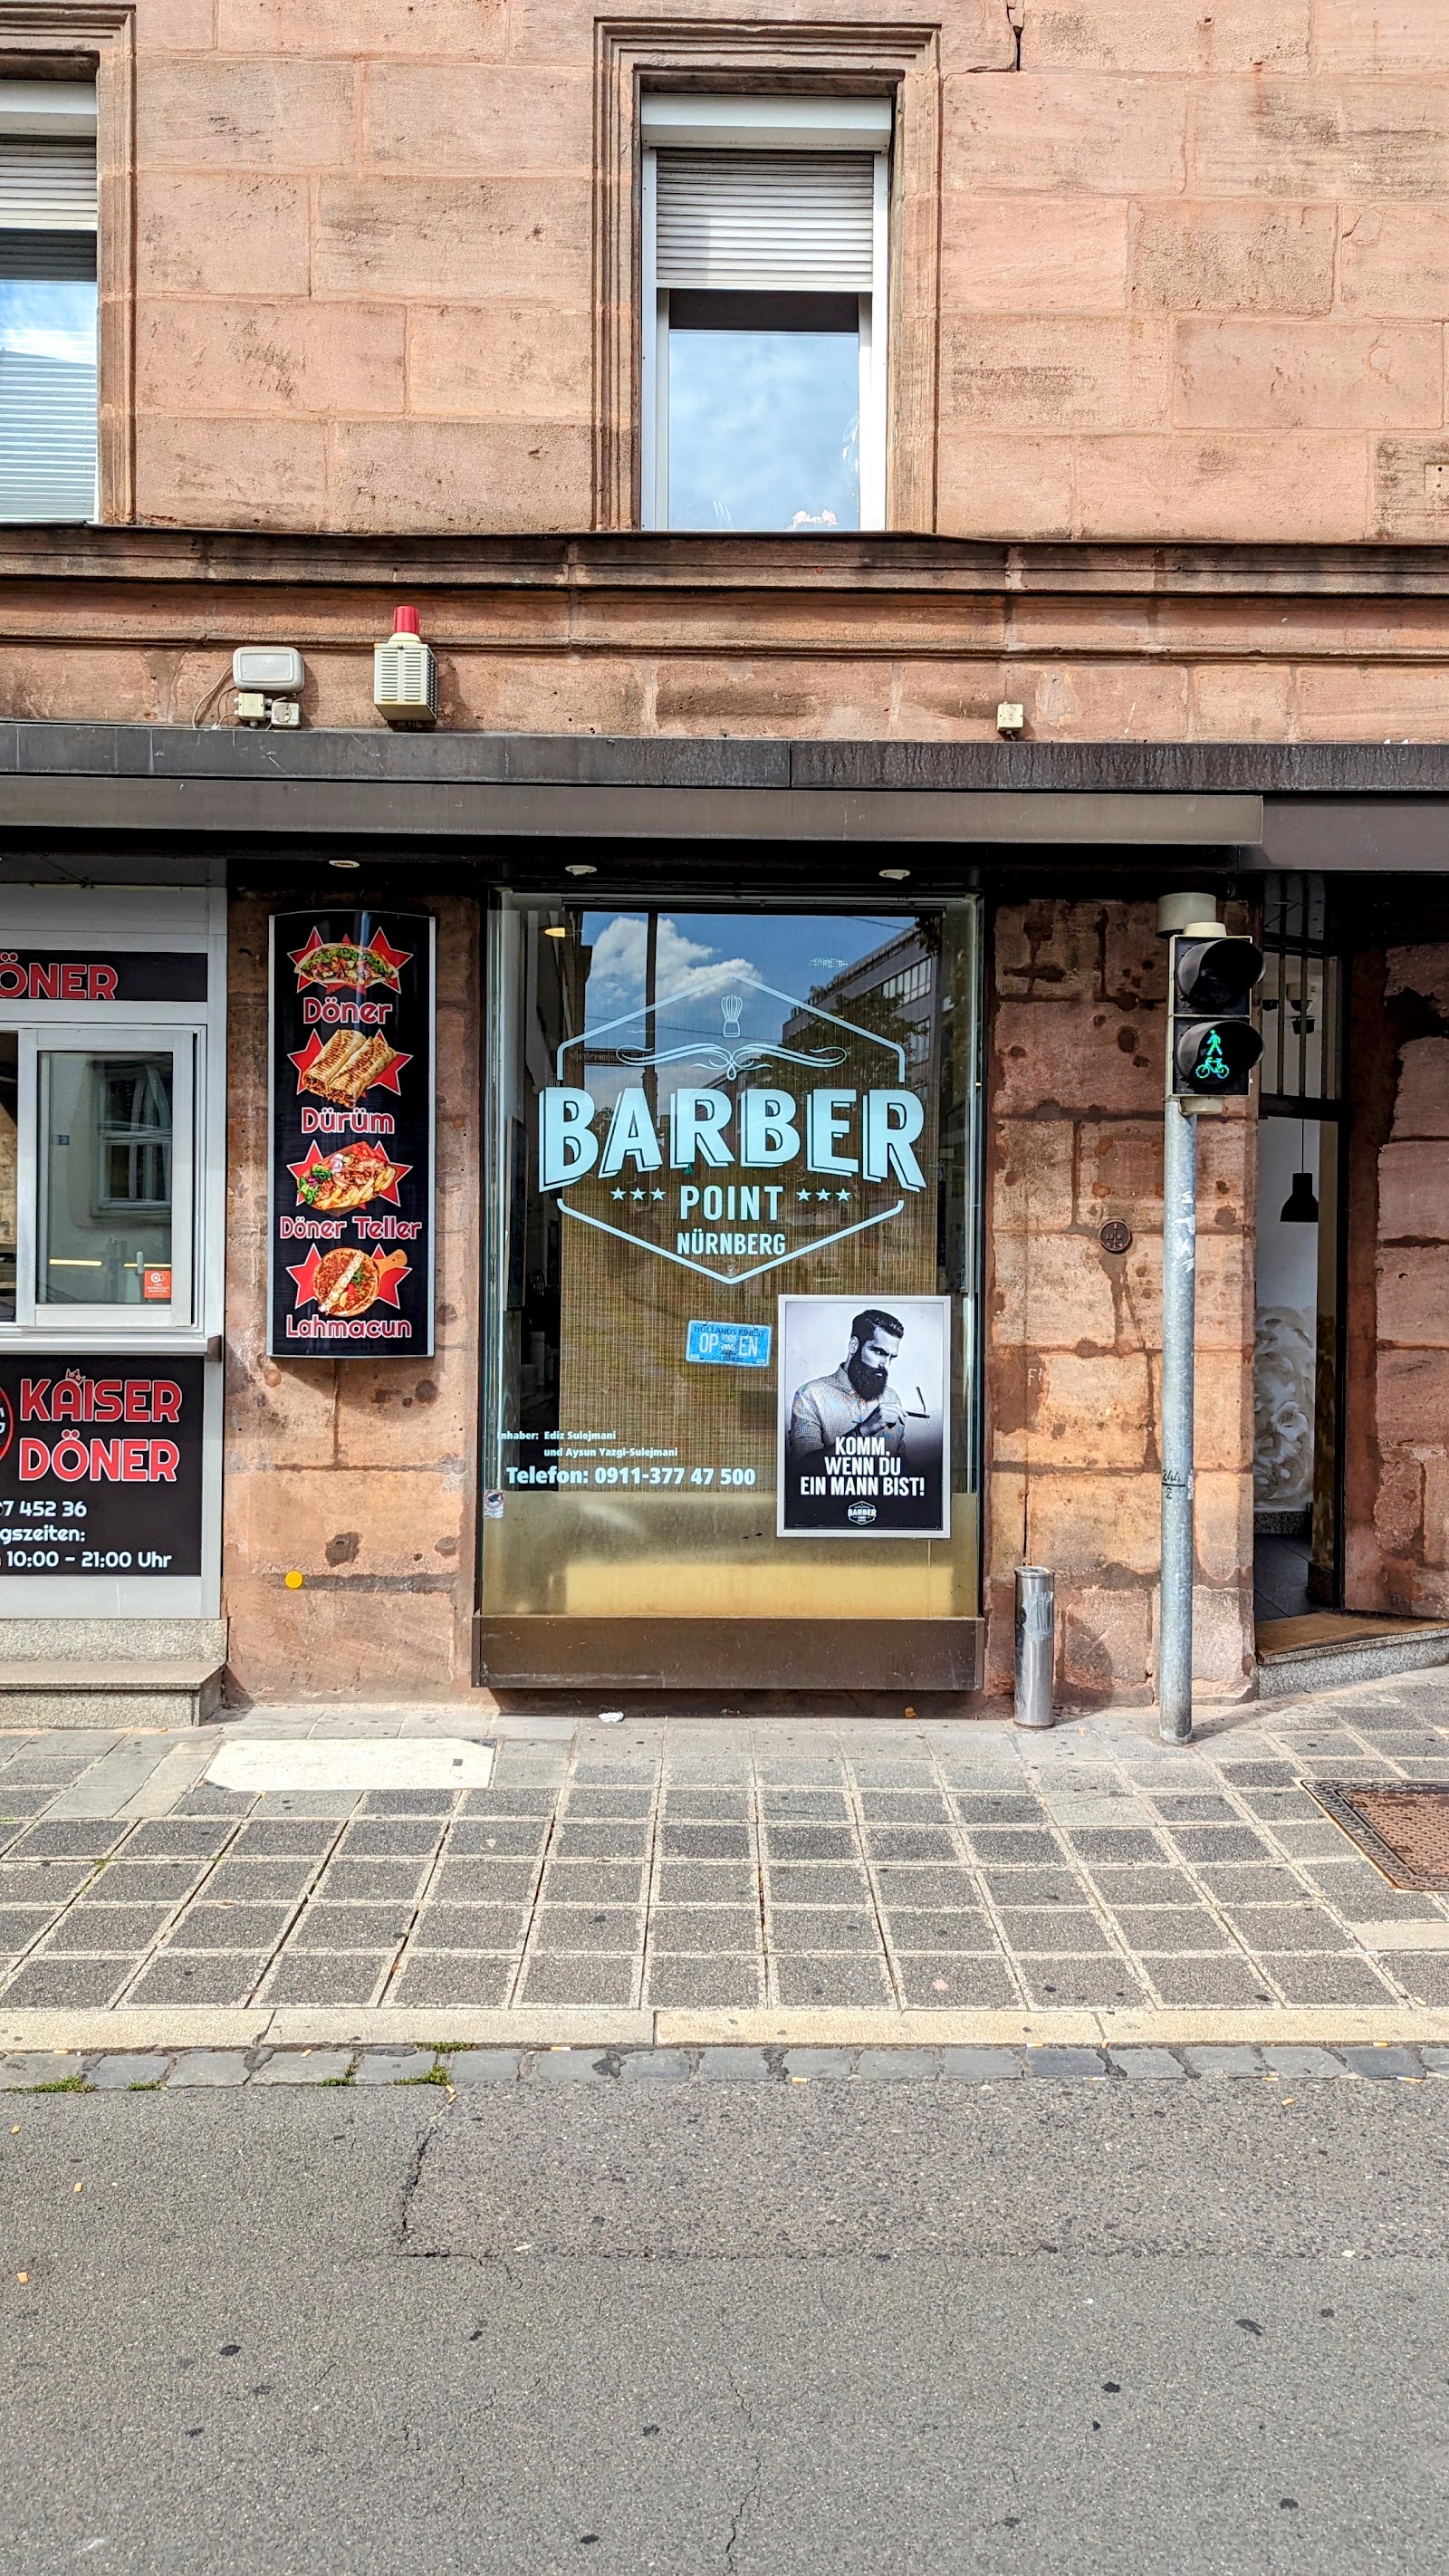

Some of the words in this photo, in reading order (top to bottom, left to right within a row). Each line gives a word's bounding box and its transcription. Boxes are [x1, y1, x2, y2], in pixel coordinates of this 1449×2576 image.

[0, 952, 119, 1000] ÖNER
[302, 997, 393, 1024] Döner
[301, 1108, 395, 1135] Dürüm
[539, 1087, 926, 1192] BARBER
[680, 1185, 784, 1221] POINT
[279, 1216, 346, 1240] Döner
[352, 1216, 422, 1240] Teller
[677, 1228, 786, 1255] NÜRNBERG
[285, 1314, 412, 1339] Lahmacun
[695, 1326, 737, 1335] HOLLANDS
[20, 1378, 183, 1422] KAISER
[497, 1431, 539, 1440] Inhaber:
[544, 1431, 565, 1440] Ediz
[567, 1431, 617, 1442] Sulejmani
[835, 1437, 890, 1457] KOMM,
[18, 1429, 181, 1482] DÖNER
[543, 1447, 563, 1456] und
[565, 1447, 596, 1459] Aysun
[599, 1447, 678, 1459] Yazgi-Sulejmani
[506, 1466, 588, 1485] Telefon:
[595, 1466, 685, 1485] 0911-377
[690, 1467, 715, 1485] 47
[720, 1468, 756, 1485] 500
[824, 1456, 874, 1475] WENN
[878, 1456, 901, 1476] DU
[801, 1476, 826, 1495] EIN
[830, 1476, 880, 1496] MANN
[883, 1477, 925, 1496] BIST!
[0, 1500, 14, 1516] 7
[19, 1500, 57, 1517] 452
[62, 1500, 88, 1517] 36
[848, 1508, 877, 1517] BARBER
[0, 1524, 86, 1545] gszeiten:
[6, 1551, 59, 1568] 10:00
[82, 1551, 132, 1569] 21:00
[138, 1551, 172, 1568] Uhr
